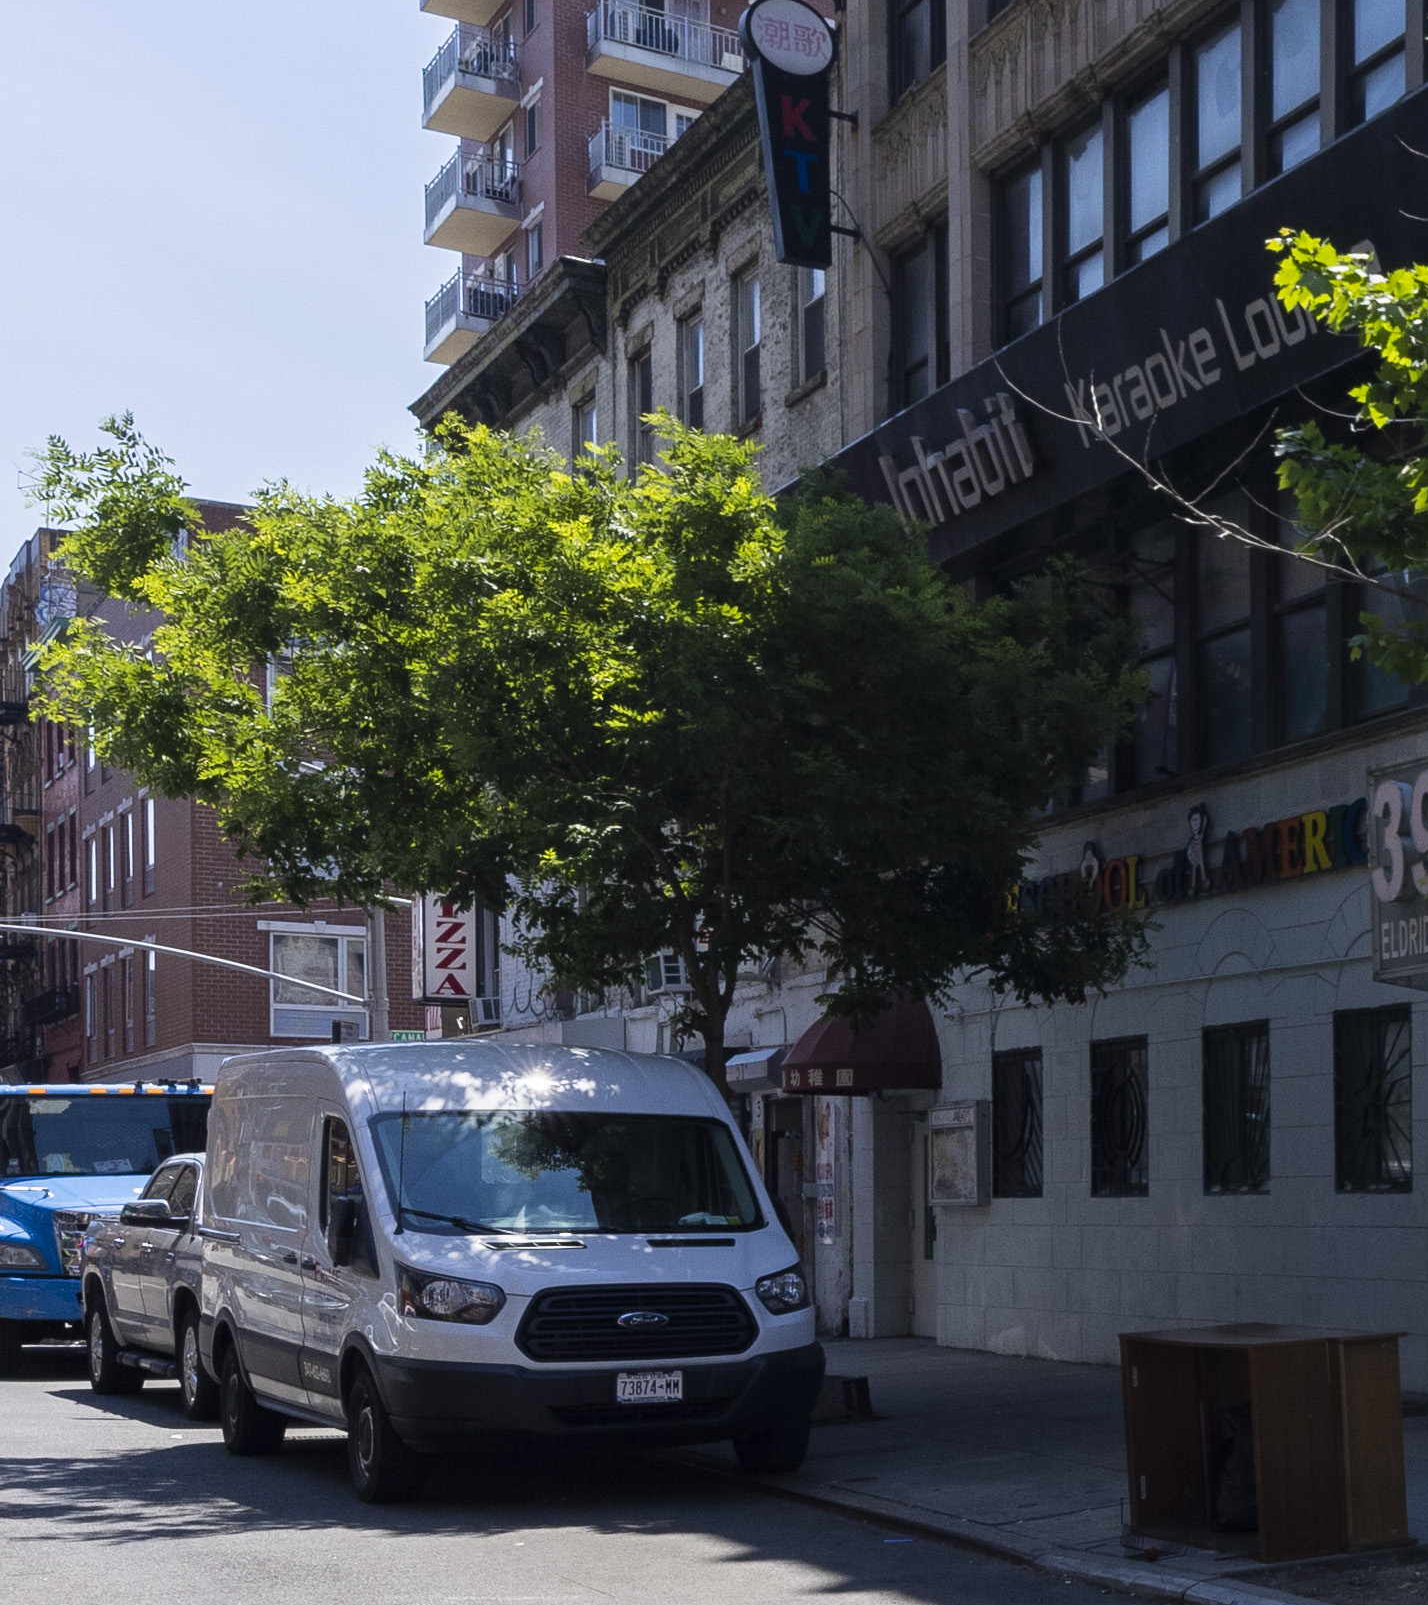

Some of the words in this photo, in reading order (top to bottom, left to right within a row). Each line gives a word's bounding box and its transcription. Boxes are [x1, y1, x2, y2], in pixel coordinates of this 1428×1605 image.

[780, 94, 823, 249] KTV
[877, 392, 1034, 530] Inhabit
[1065, 328, 1221, 449] Karaoke
[1220, 798, 1368, 892] AMERIC
[431, 898, 471, 996] IZZA
[782, 1068, 853, 1088] 幼稚園
